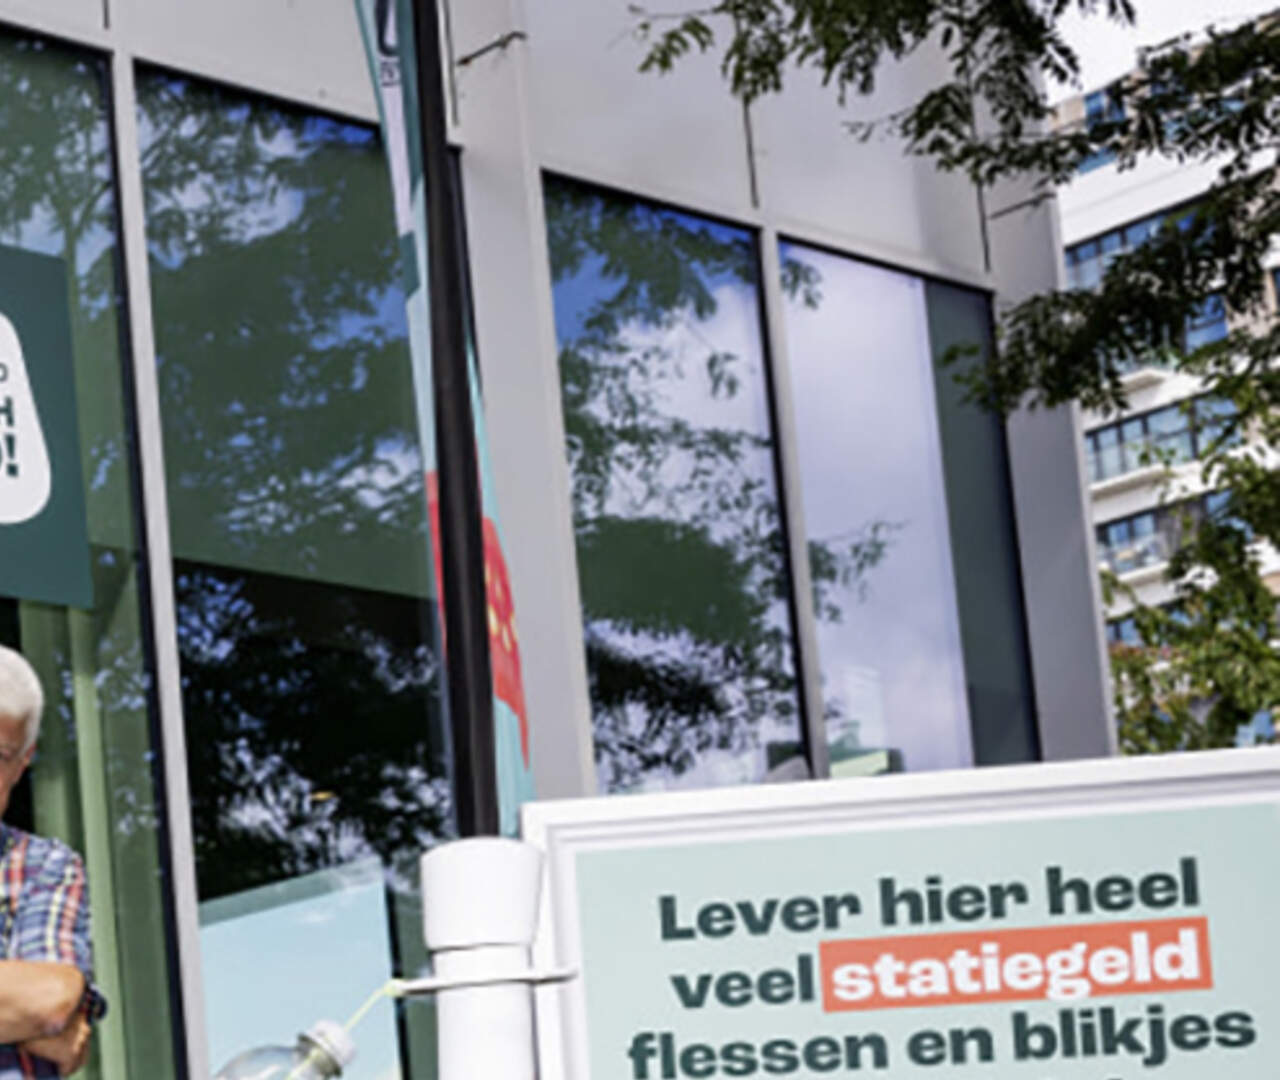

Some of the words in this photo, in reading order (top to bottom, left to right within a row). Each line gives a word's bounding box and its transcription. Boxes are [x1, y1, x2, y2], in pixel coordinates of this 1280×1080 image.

[658, 893, 862, 941] Lever
[879, 876, 1029, 928] hier
[1046, 857, 1200, 916] heel
[670, 954, 815, 1010] veel
[832, 928, 1202, 1002] statiegeld
[907, 1023, 994, 1067] en
[1013, 1004, 1257, 1068] blikjes
